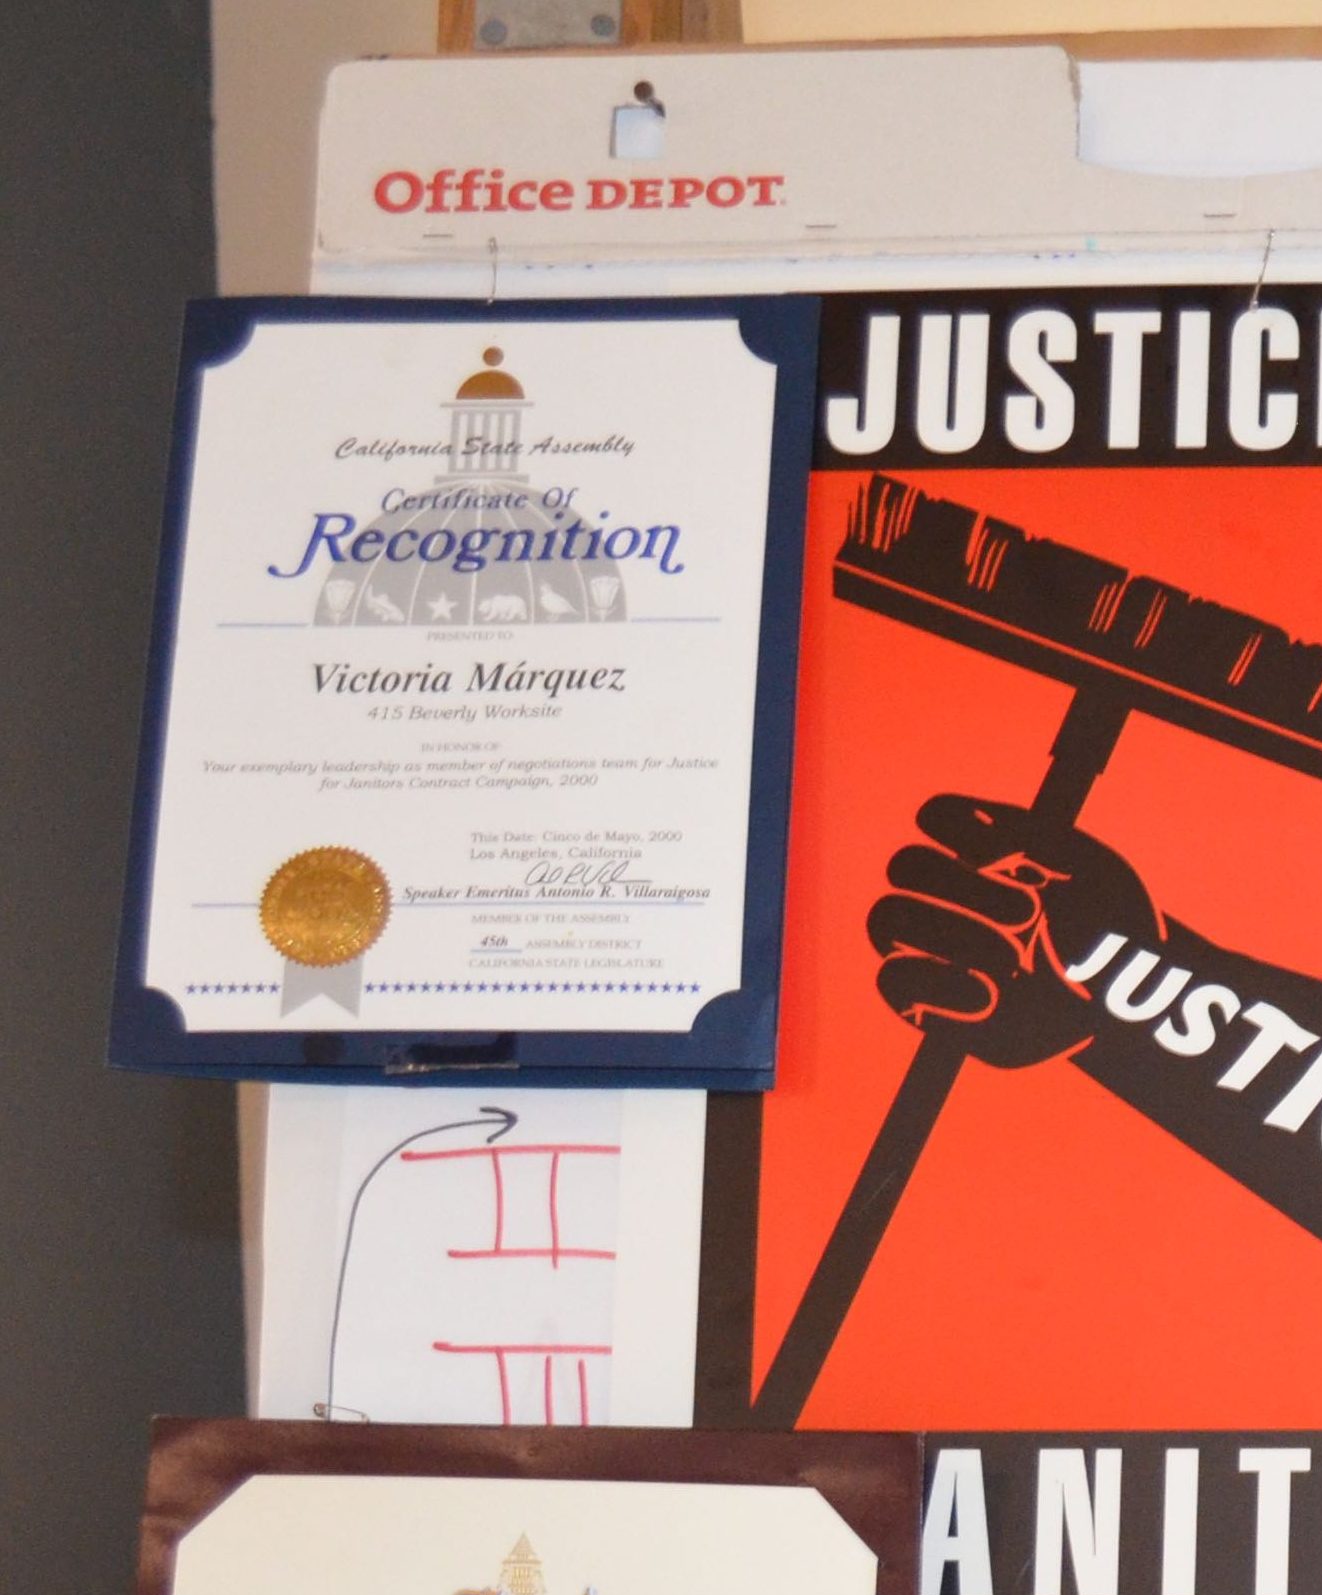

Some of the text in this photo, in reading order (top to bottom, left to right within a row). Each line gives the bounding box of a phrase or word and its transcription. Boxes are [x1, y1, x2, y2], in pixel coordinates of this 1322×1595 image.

[374, 168, 786, 213] Office DEPOT
[335, 435, 635, 462] California State Assembly
[381, 486, 580, 516] Certificate Of
[267, 509, 685, 577] Recognition
[313, 660, 626, 698] Victoria Márquez
[368, 703, 562, 723] 415 Beverly Worksite
[471, 830, 498, 844] This
[543, 830, 581, 843] Cinco
[585, 830, 601, 842] de
[650, 830, 683, 843] 2000
[470, 846, 642, 862] Los Angeles, California
[403, 883, 711, 902] Speaker Emeritus Antonio R. Villaraigosa
[480, 935, 508, 948] 45th
